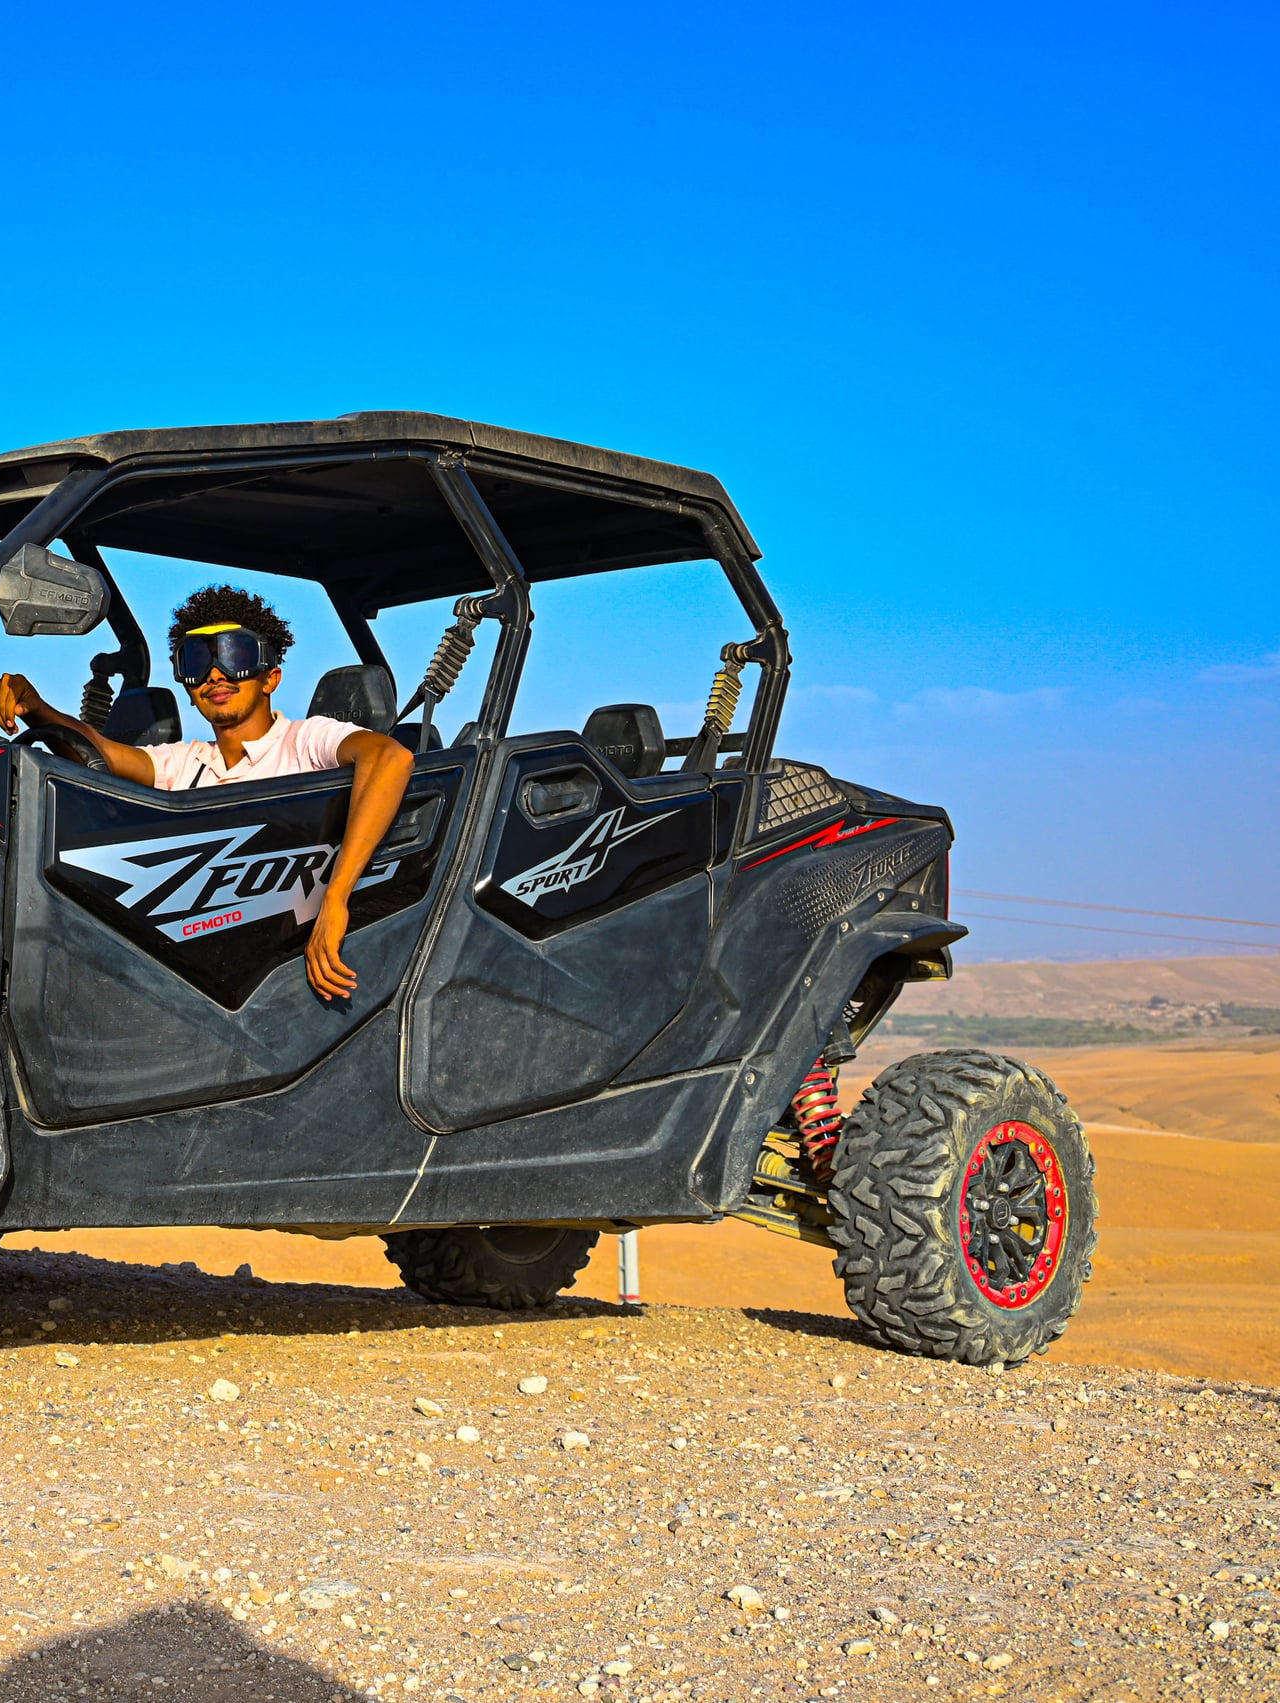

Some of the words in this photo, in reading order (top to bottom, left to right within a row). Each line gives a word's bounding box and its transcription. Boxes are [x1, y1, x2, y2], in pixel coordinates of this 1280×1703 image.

[39, 589, 89, 606] CFMOTO
[596, 744, 635, 758] MOTO
[112, 826, 396, 925] ZFOR
[515, 863, 588, 897] SPORT
[182, 910, 243, 937] CFMOTO
